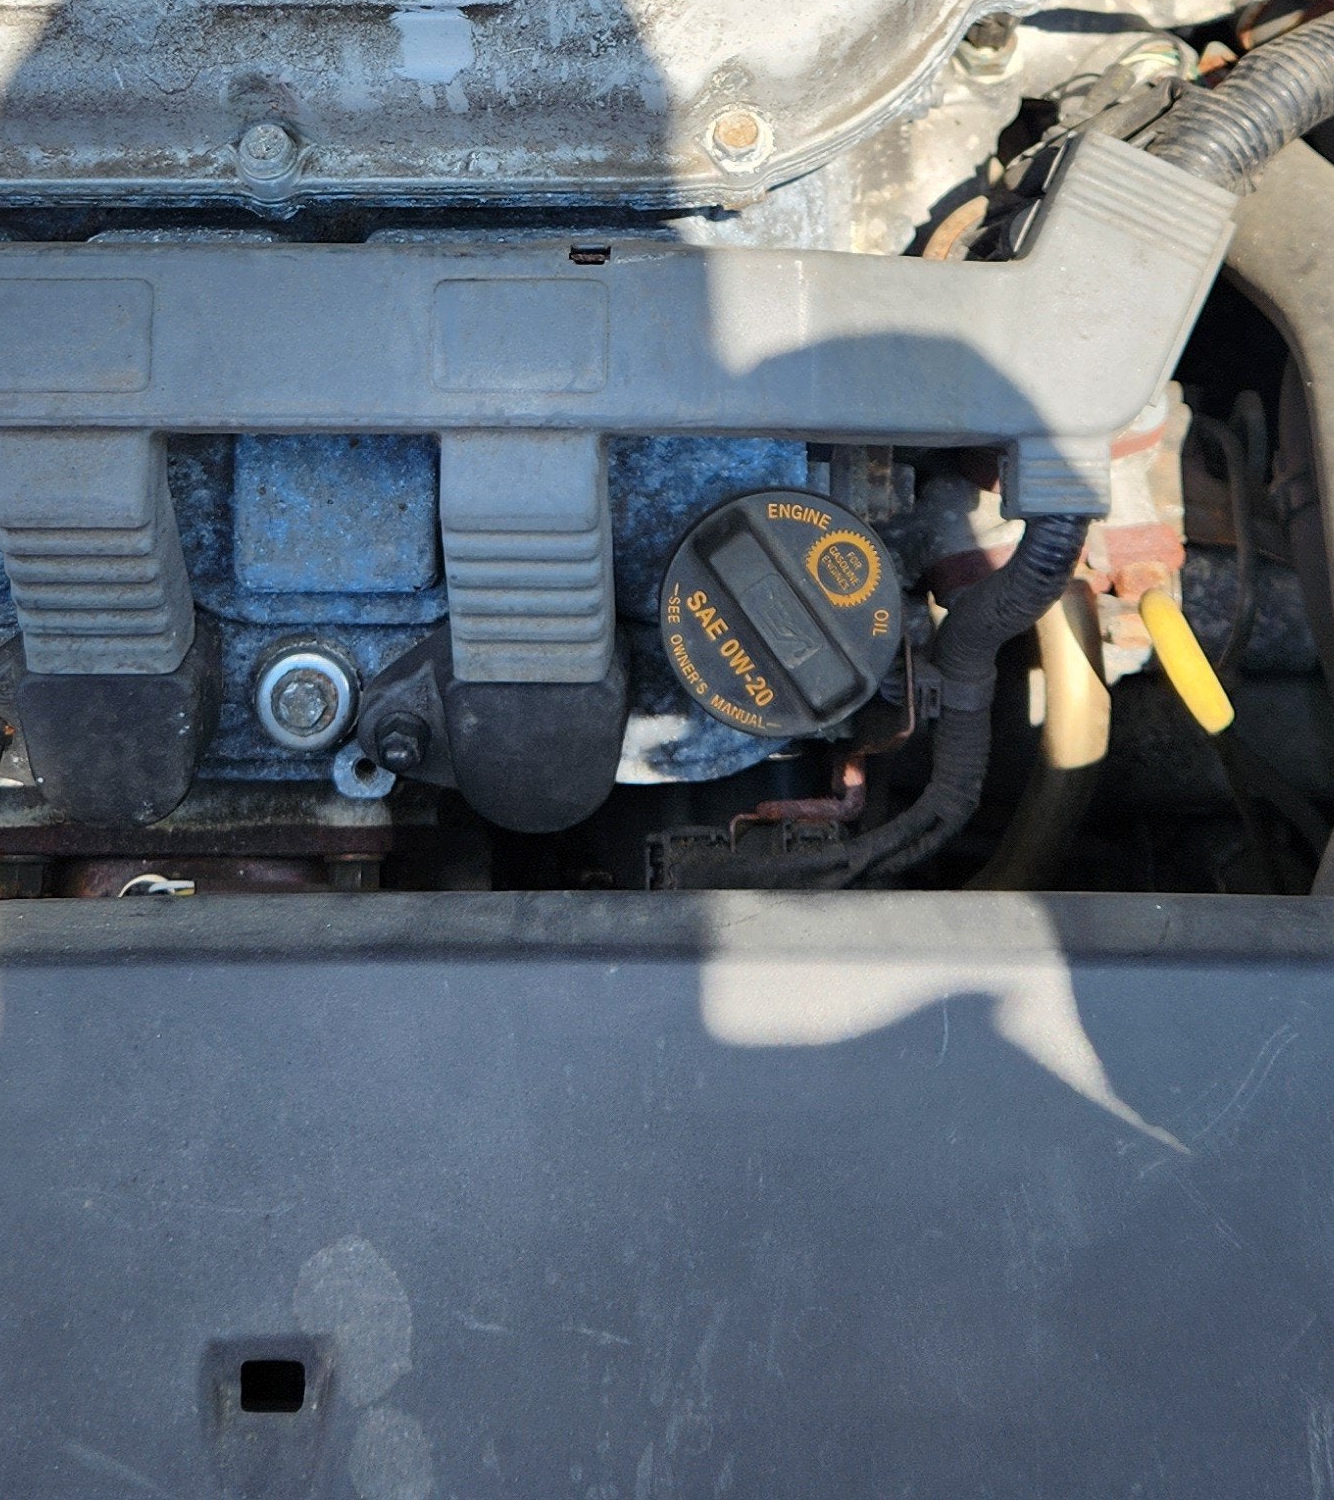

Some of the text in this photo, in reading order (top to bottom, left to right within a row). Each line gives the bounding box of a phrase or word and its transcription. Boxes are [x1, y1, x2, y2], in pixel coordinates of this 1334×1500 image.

[767, 503, 890, 637] ENGINE OIL
[822, 555, 850, 591] ENGINES
[829, 545, 860, 587] GASOLINE
[847, 551, 863, 570] FOR
[670, 633, 708, 695] OWNER'S
[687, 590, 774, 707] SAE 0W-20
